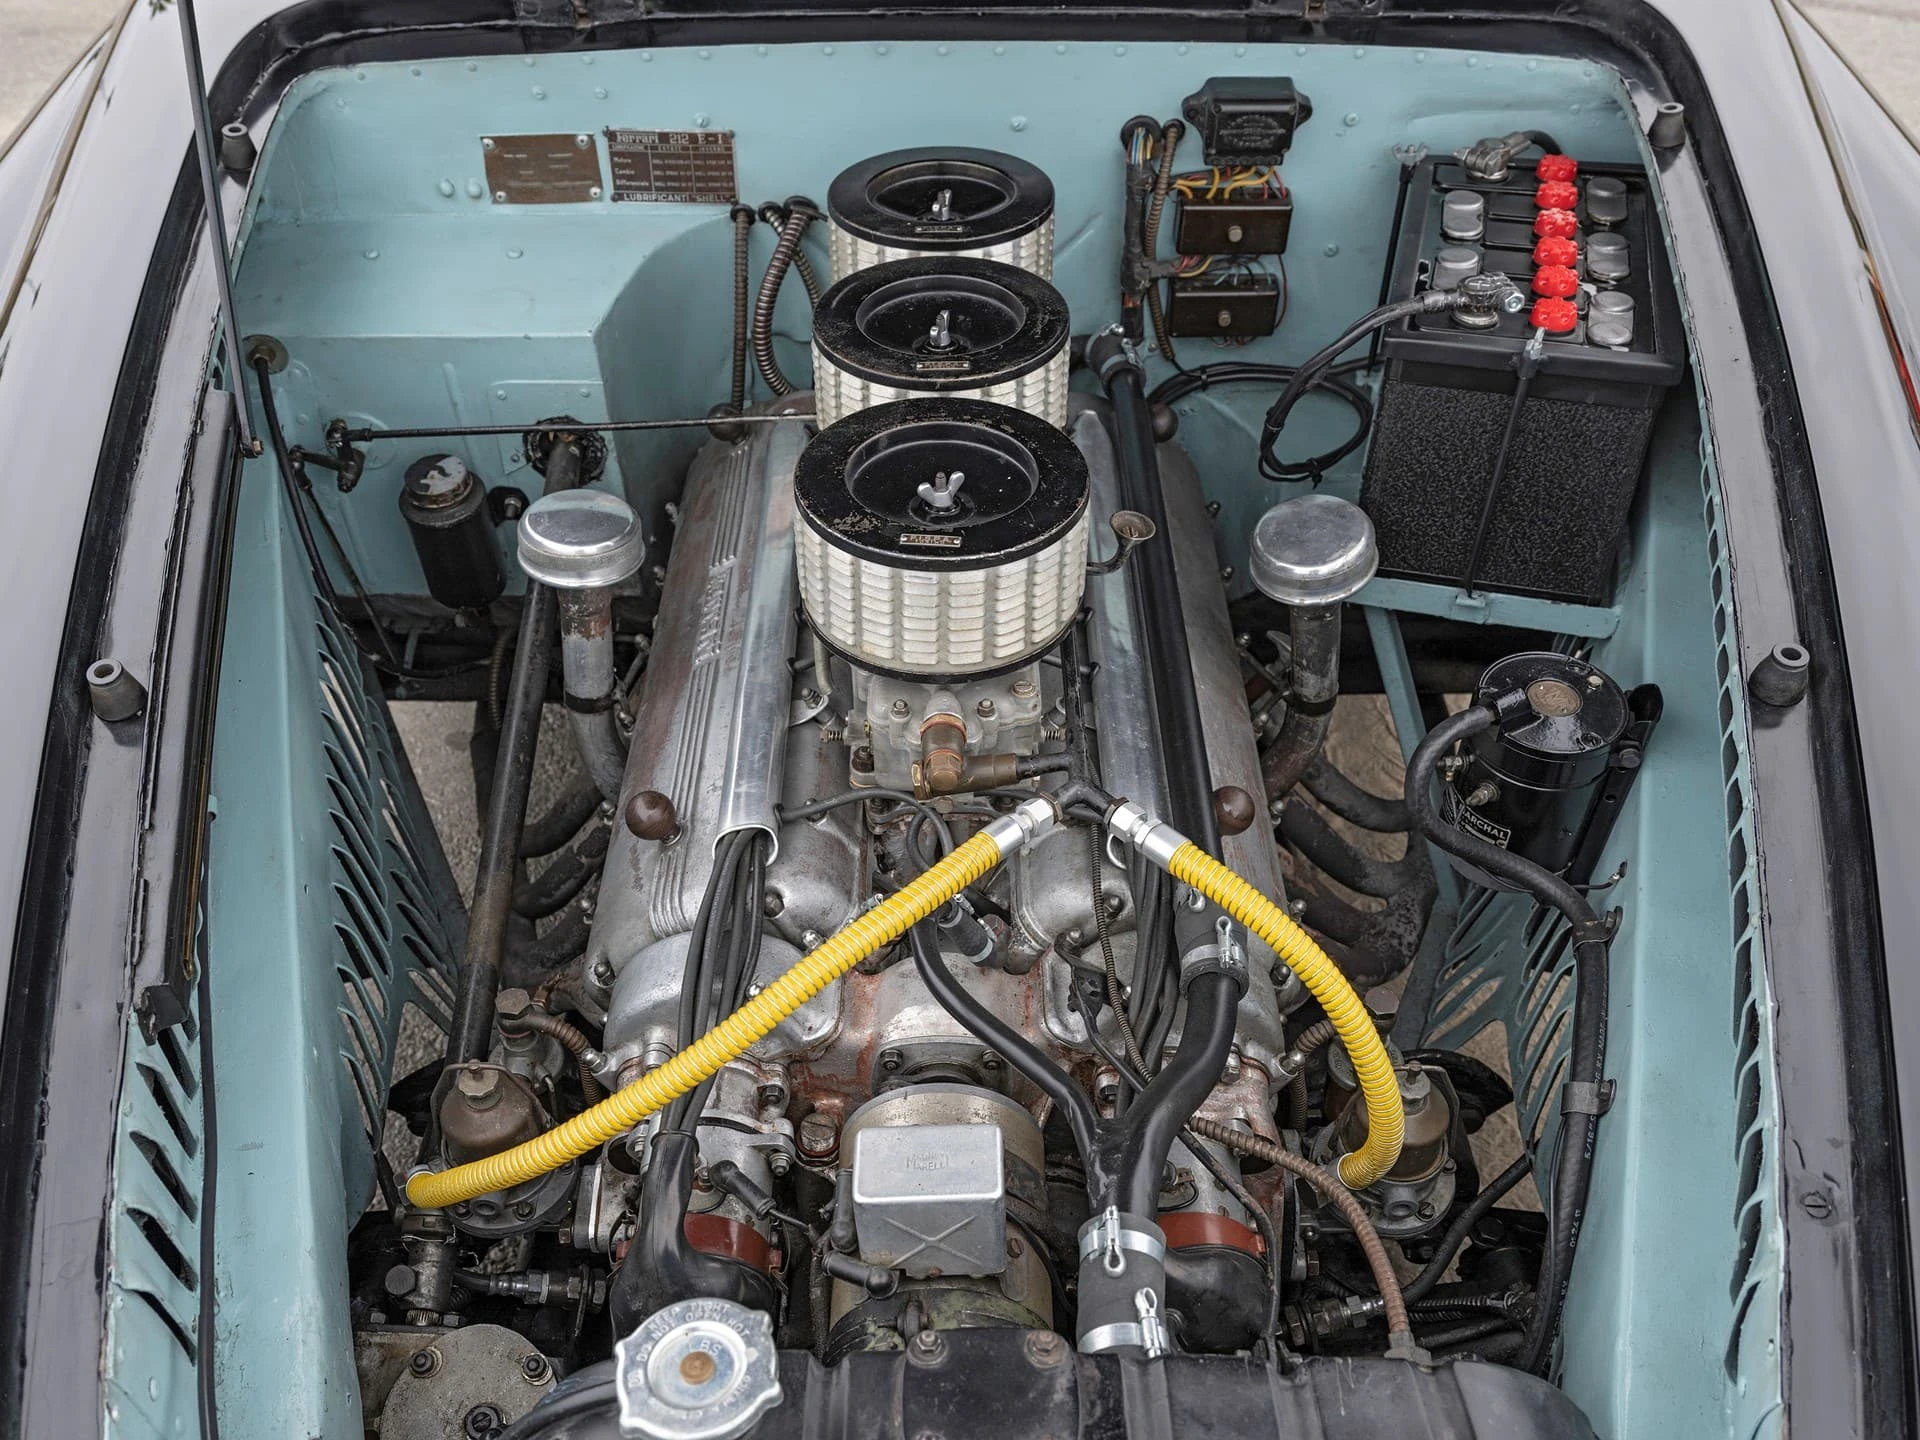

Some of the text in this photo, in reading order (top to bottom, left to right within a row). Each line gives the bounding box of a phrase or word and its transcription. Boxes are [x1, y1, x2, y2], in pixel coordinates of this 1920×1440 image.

[616, 132, 658, 144] Ferrari
[669, 134, 689, 145] 212
[623, 192, 690, 202] LUBRIFICANTI
[1462, 811, 1506, 840] ARCHAL
[691, 1302, 731, 1313] TIGHT
[636, 1311, 751, 1362] DO NOT OPEN HOT
